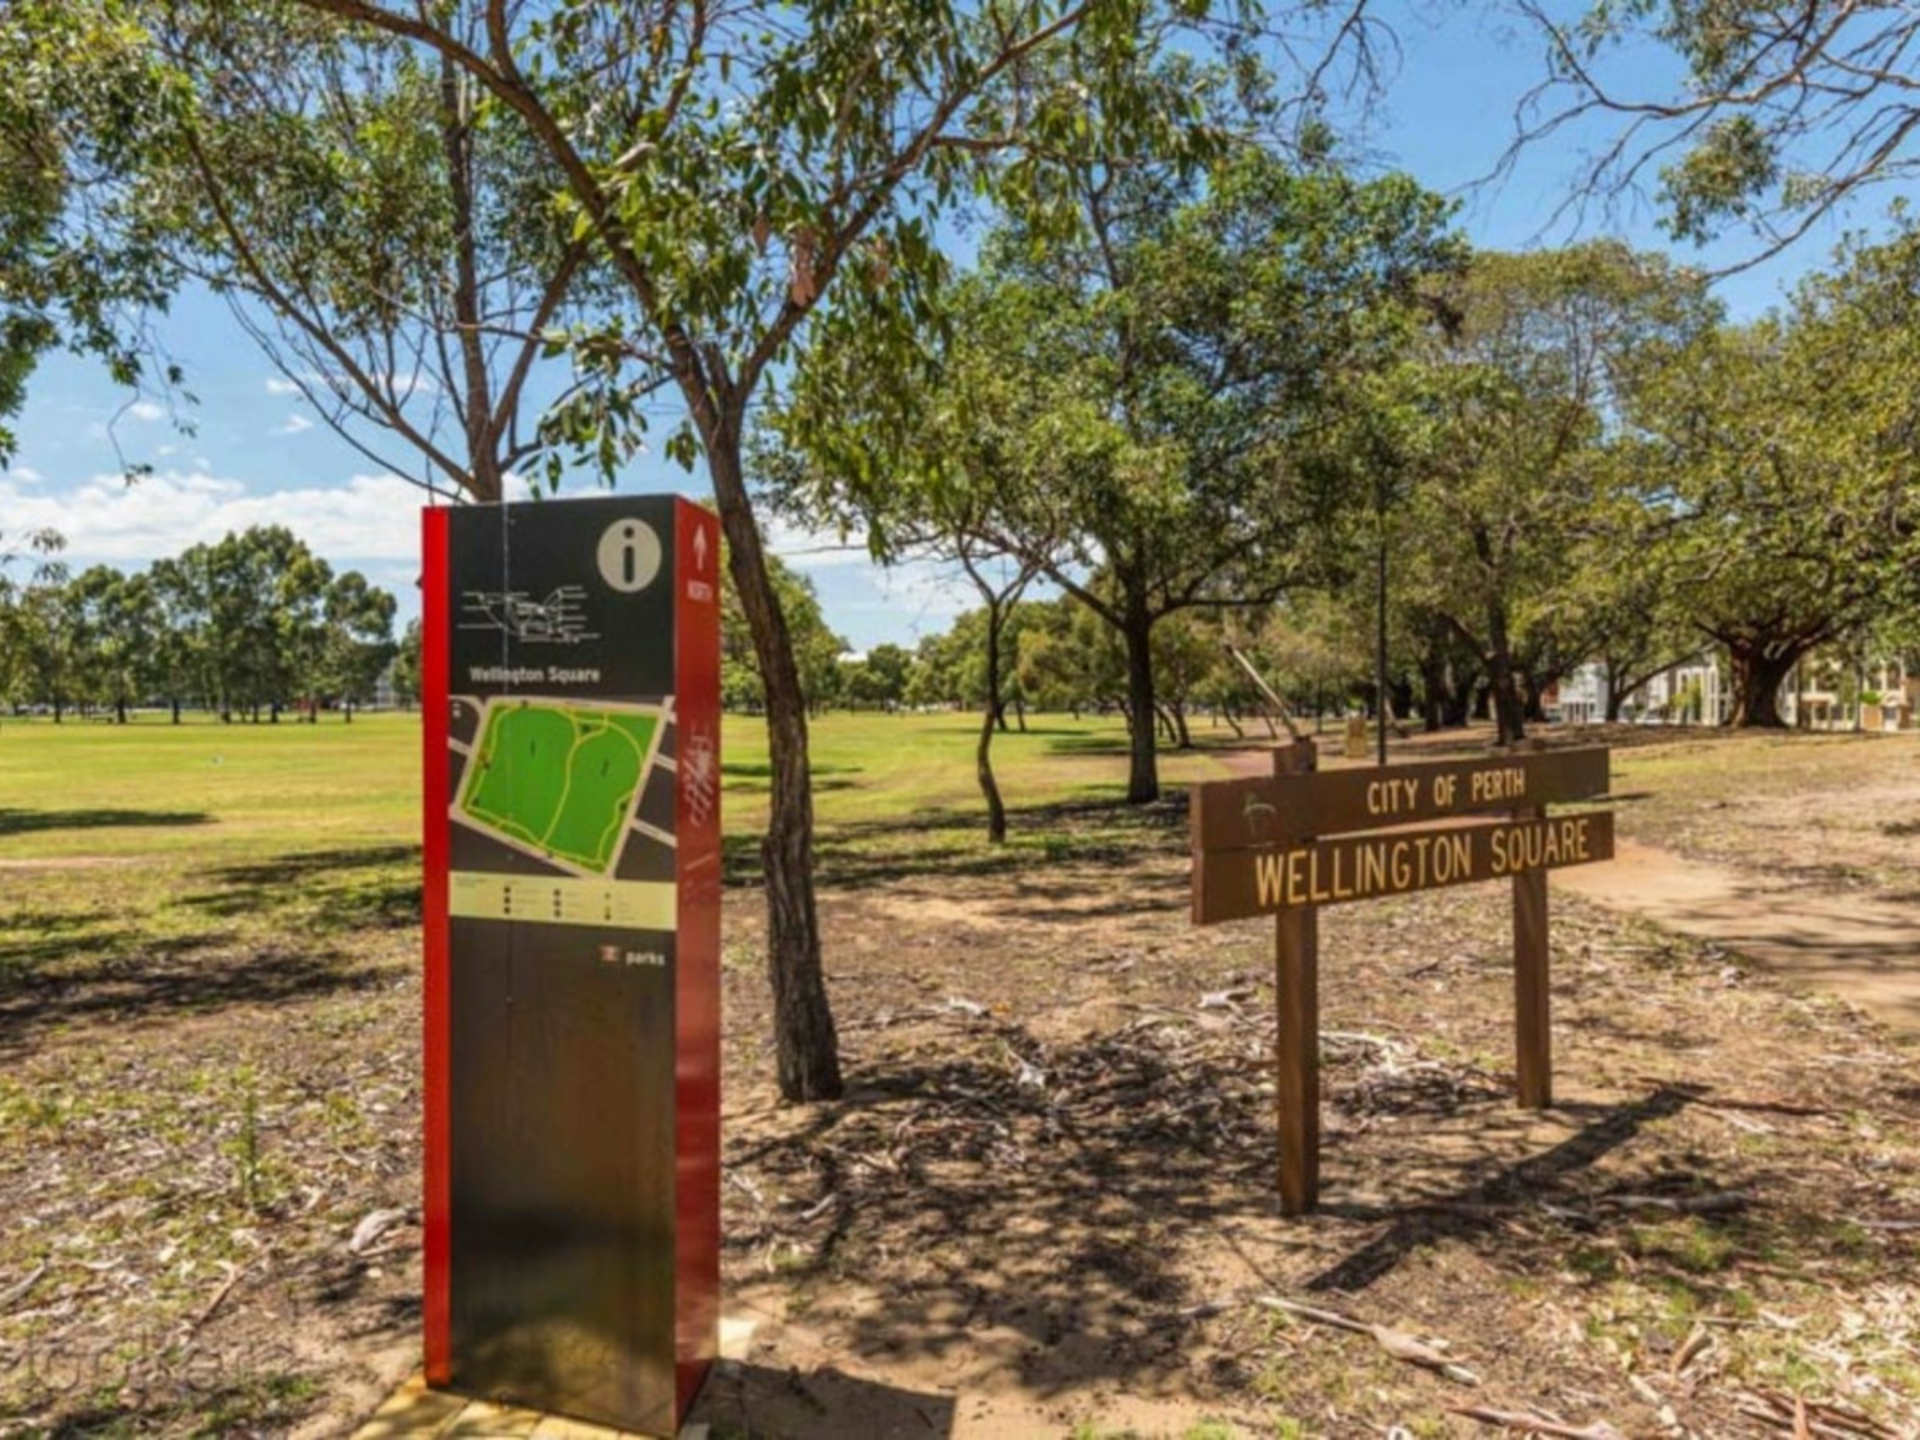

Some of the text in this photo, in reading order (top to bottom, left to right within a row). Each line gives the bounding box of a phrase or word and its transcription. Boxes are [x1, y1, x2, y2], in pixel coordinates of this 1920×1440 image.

[469, 666, 600, 685] Wellington Square
[1366, 768, 1526, 815] CITY OF PERTH
[1255, 818, 1590, 907] WELLINGTON SQUARE
[625, 951, 665, 967] parks
